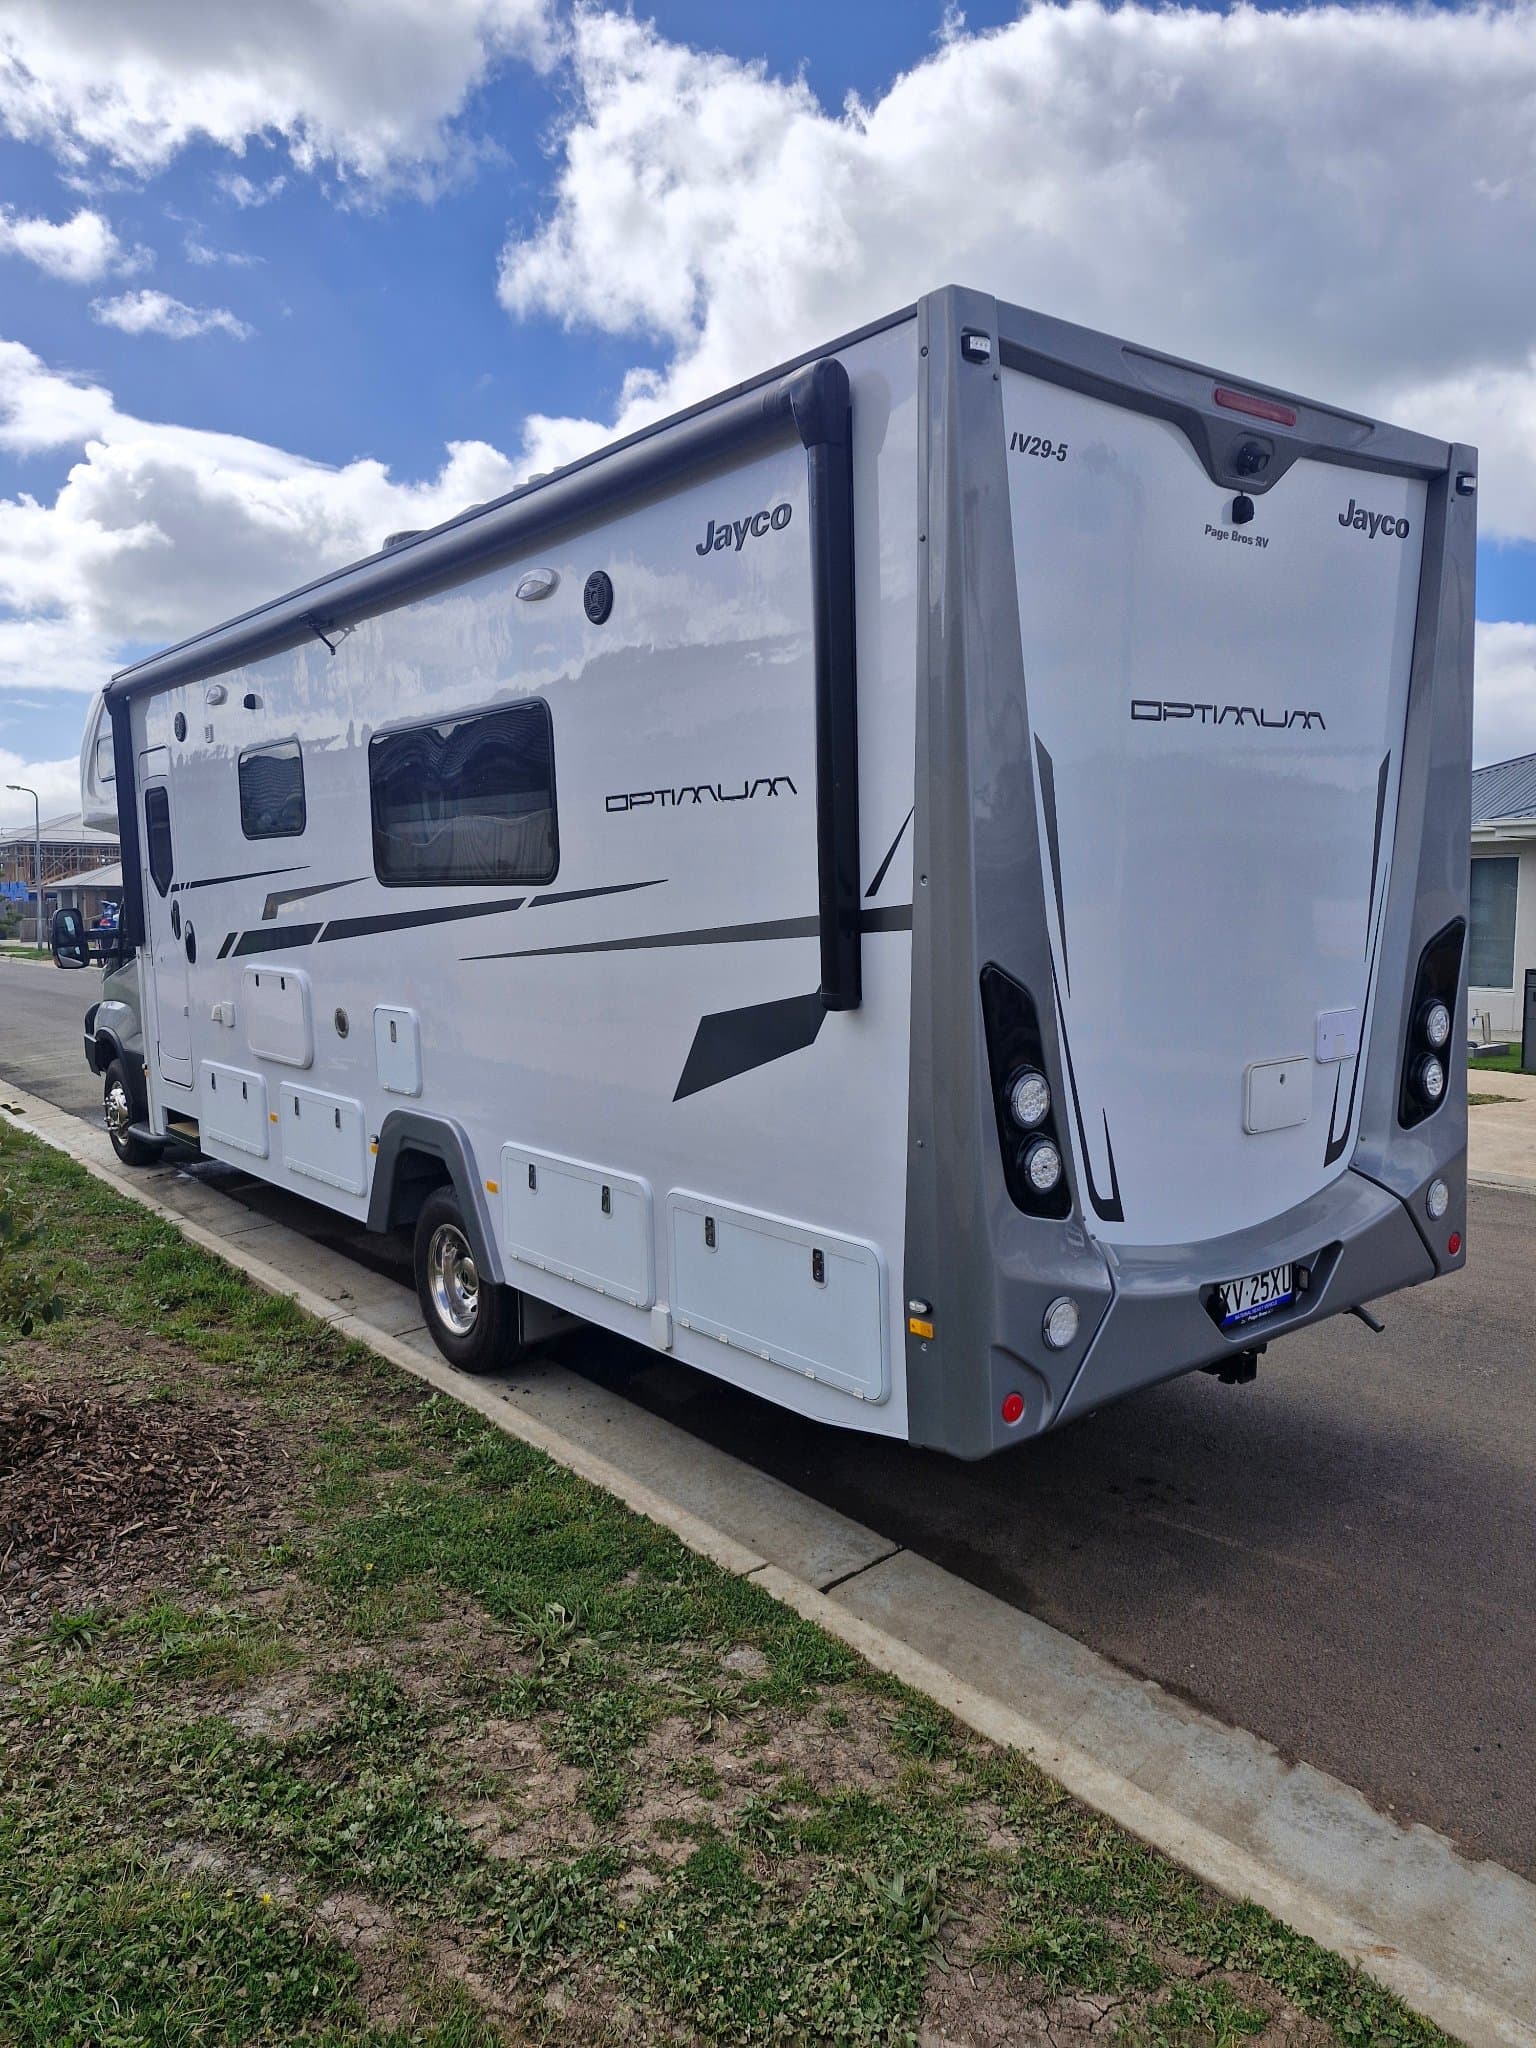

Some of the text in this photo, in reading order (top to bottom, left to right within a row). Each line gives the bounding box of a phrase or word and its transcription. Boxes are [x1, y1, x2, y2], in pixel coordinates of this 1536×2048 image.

[1009, 431, 1069, 462] IV29-5
[695, 502, 793, 556] Jayco
[1204, 523, 1269, 548] Page Bros RV
[1338, 498, 1410, 540] Jayco
[1130, 699, 1326, 731] OPTIMUM
[605, 776, 798, 813] OPTIMUM
